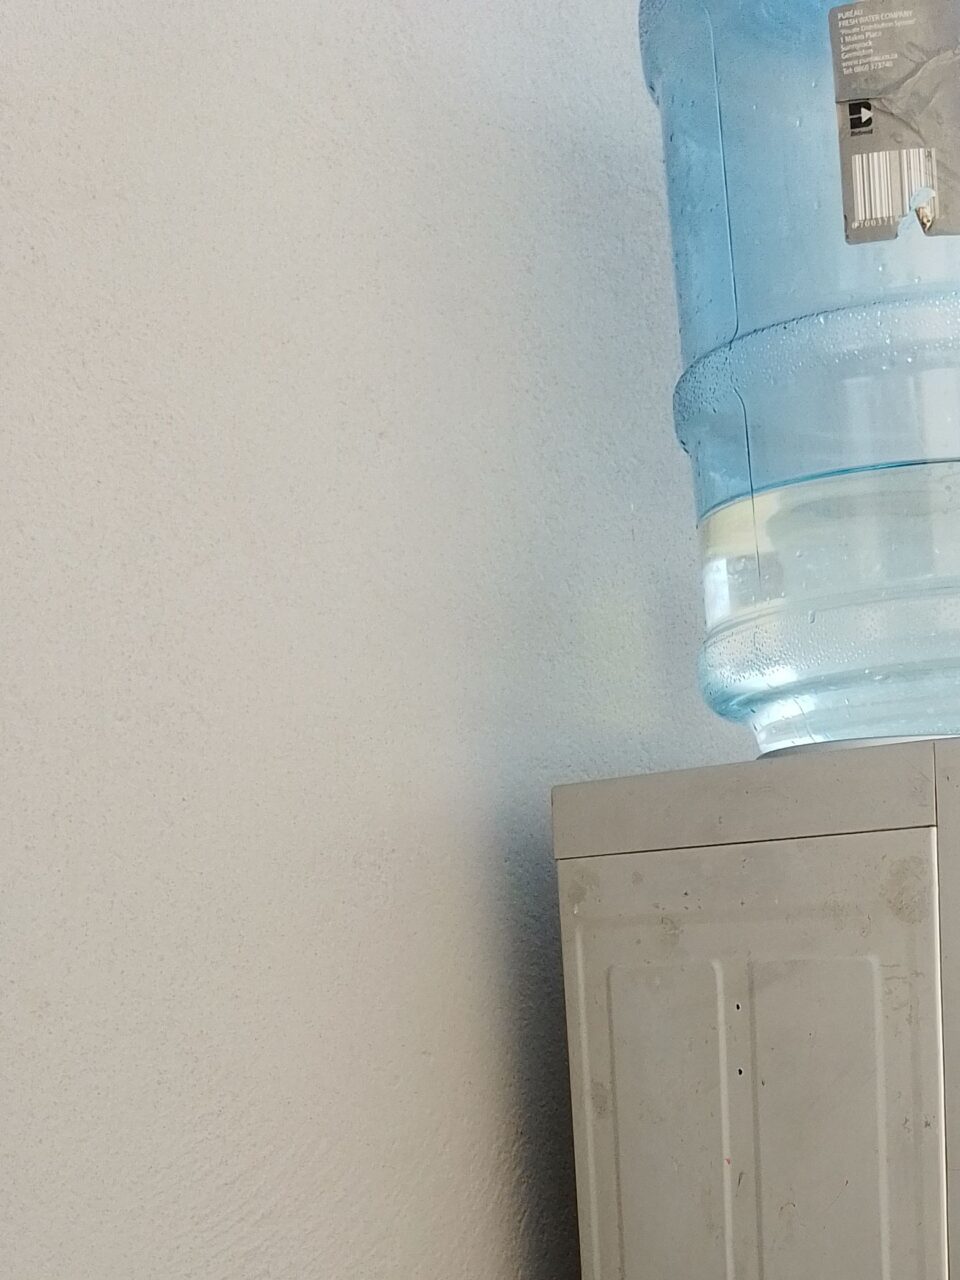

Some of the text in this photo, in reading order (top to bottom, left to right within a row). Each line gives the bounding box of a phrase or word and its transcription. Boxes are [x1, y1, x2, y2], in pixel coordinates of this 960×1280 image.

[838, 10, 913, 28] FRESH WATER COMPANY
